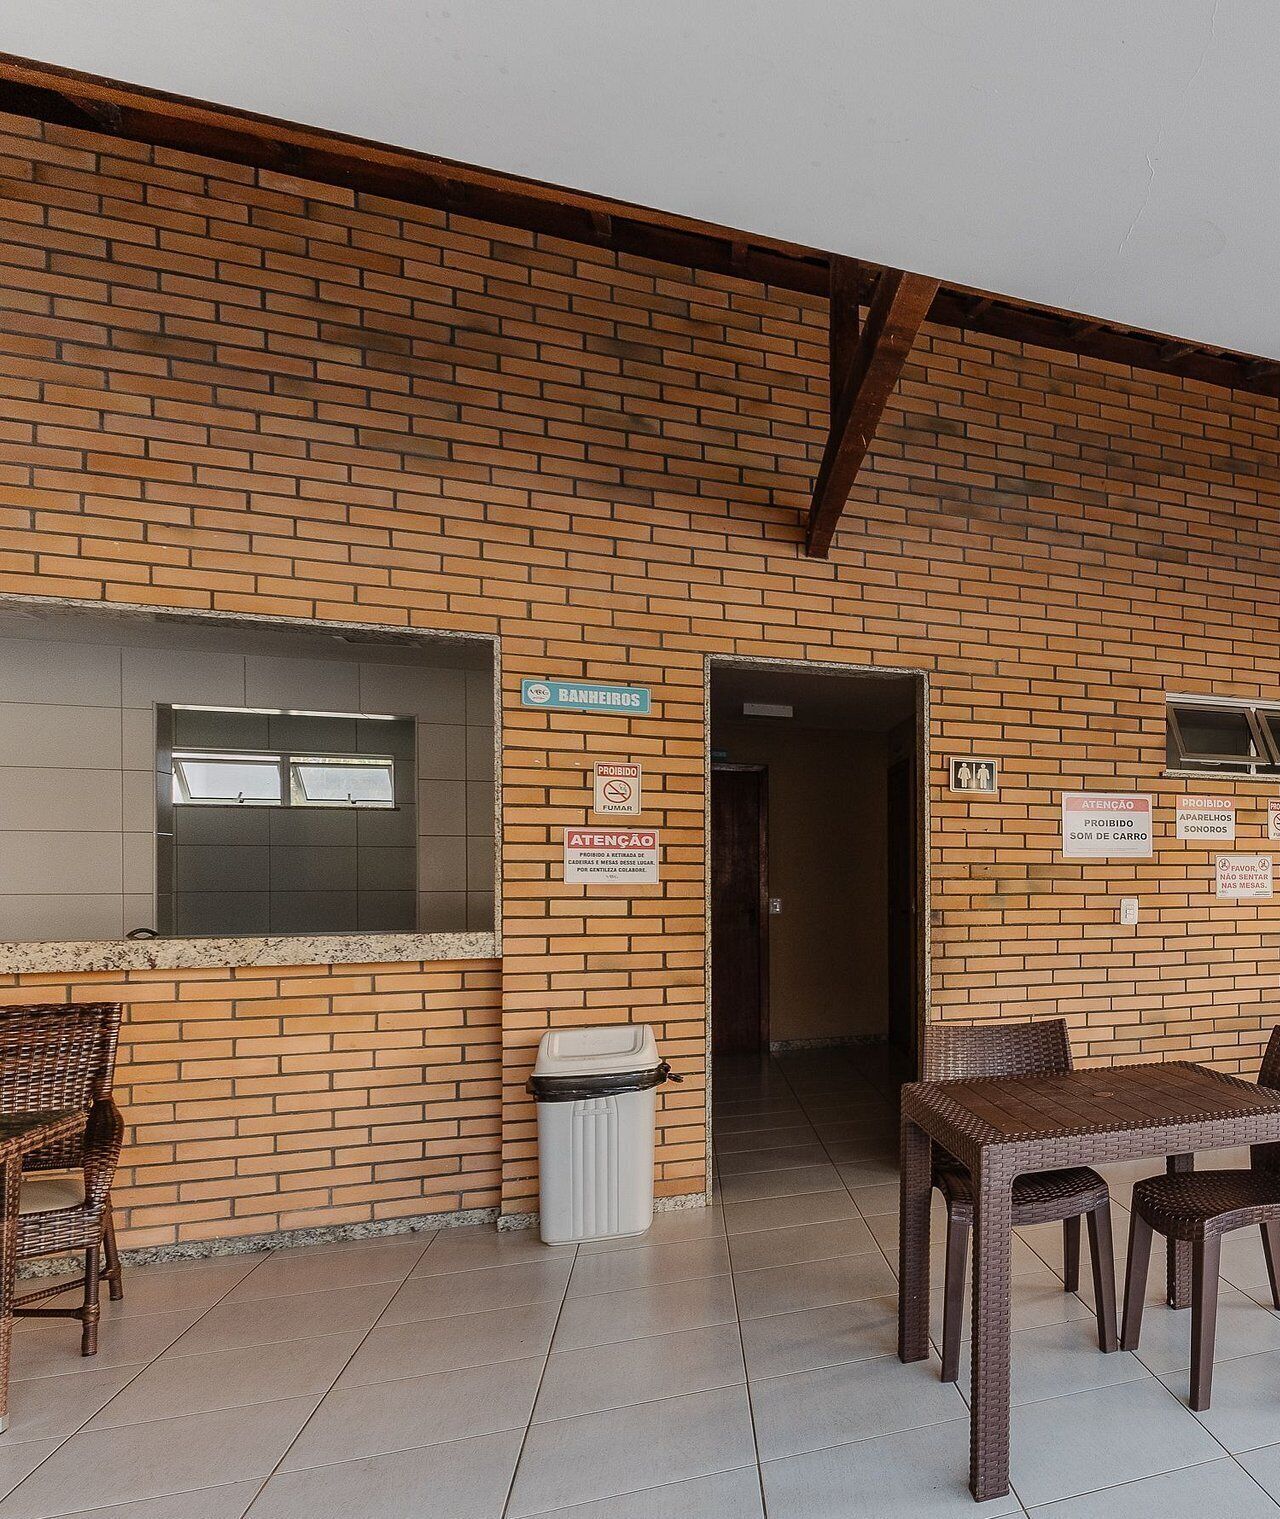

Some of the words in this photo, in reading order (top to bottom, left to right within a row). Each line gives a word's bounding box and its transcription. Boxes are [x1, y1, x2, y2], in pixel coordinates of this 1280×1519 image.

[558, 688, 640, 707] BANHEIROS
[598, 765, 637, 776] PROIBIDO
[1081, 799, 1135, 811] ATENÇÃO
[1182, 799, 1232, 808] PROIBIDO
[1179, 813, 1232, 822] APARELHOS
[1084, 819, 1134, 828] PROIBIDO
[1184, 825, 1228, 834] SONOROS
[1069, 832, 1093, 840] SOM
[1096, 832, 1110, 840] DE
[1112, 832, 1148, 840] CARRO
[570, 833, 654, 849] ATENÇÃO
